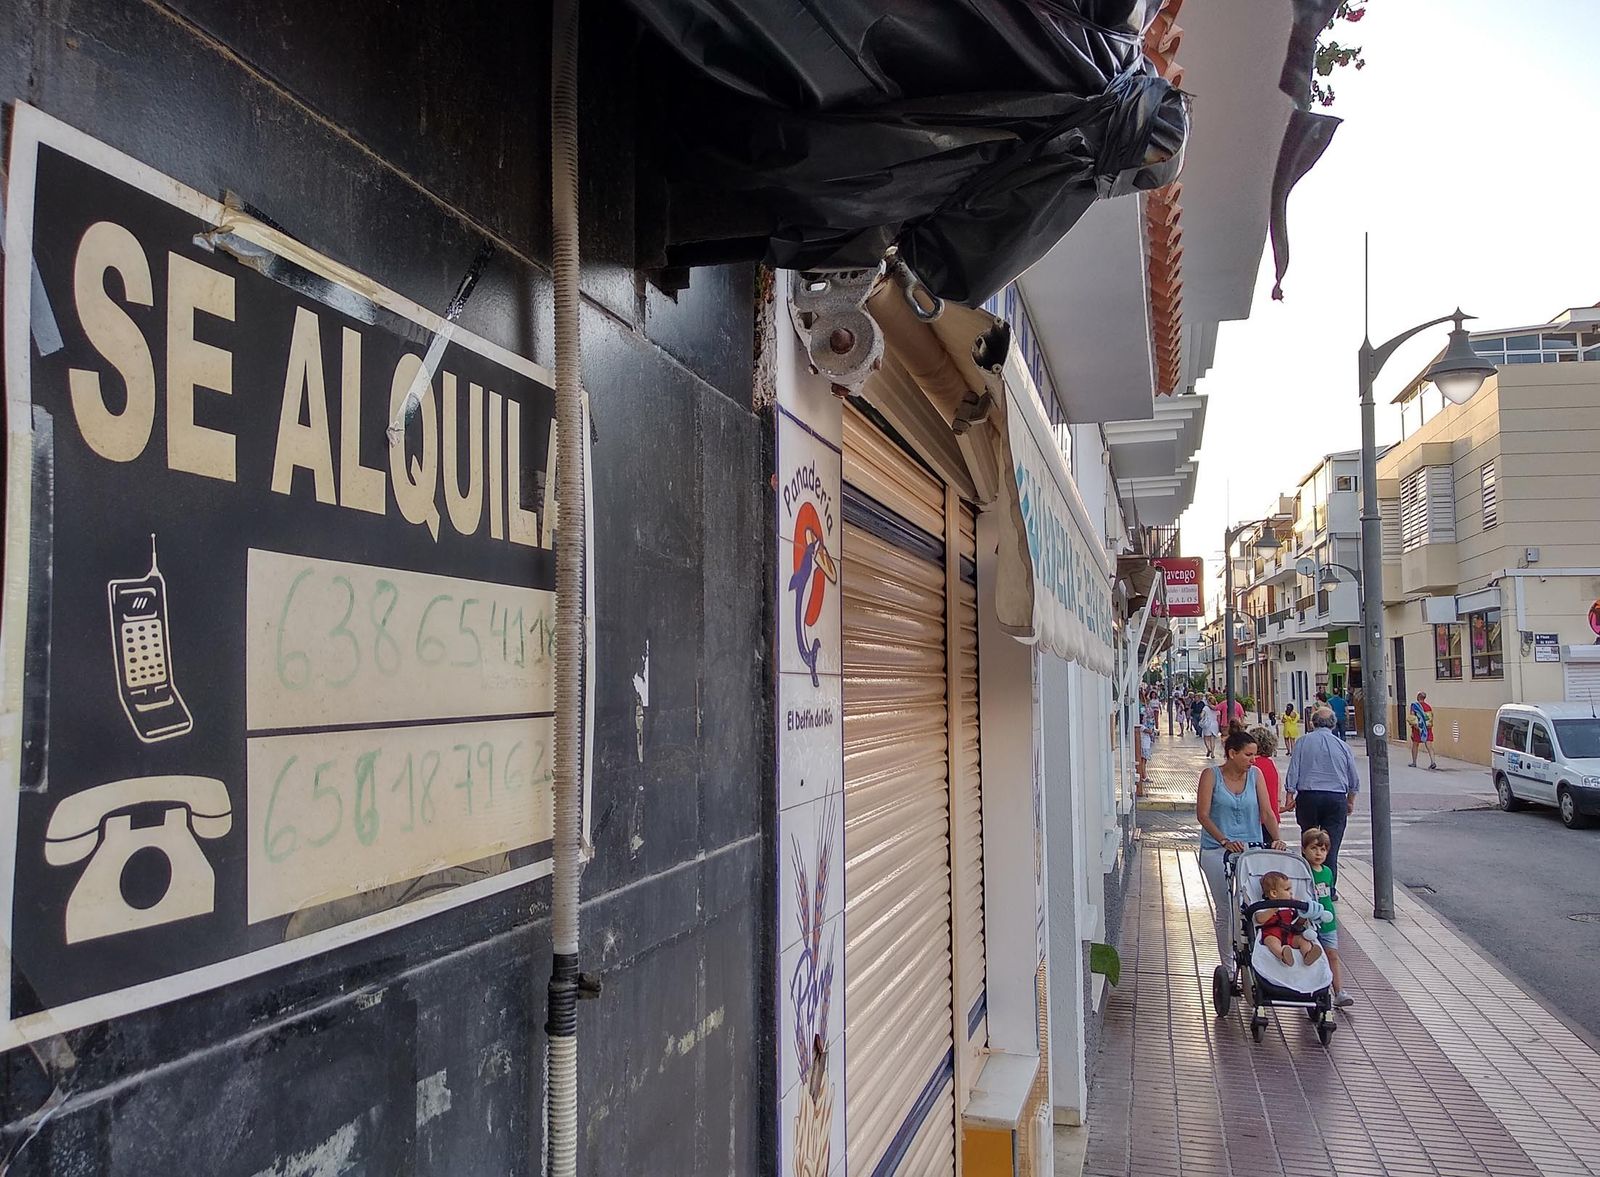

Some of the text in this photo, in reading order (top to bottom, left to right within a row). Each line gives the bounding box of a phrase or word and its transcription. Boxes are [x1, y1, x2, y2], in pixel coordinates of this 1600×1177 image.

[68, 220, 237, 483] SE
[787, 710, 794, 731] El
[814, 707, 824, 728] del
